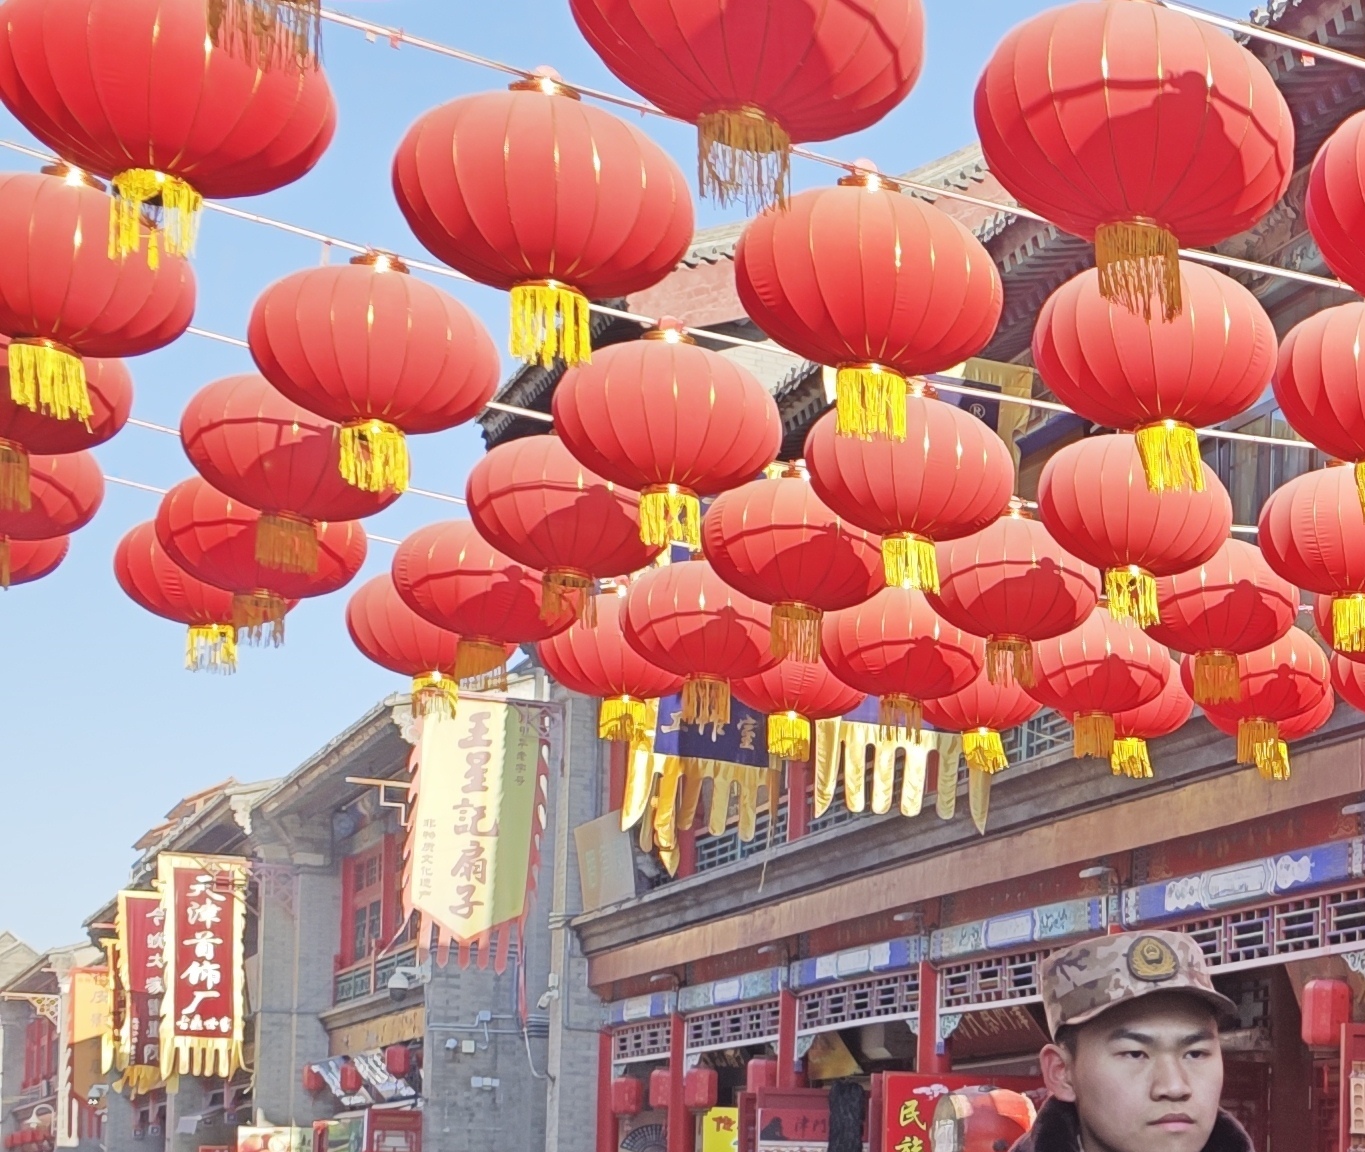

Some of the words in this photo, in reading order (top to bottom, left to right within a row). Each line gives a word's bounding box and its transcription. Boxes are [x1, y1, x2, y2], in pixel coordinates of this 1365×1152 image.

[448, 711, 500, 919] 王星記扇子
[180, 874, 227, 1015] 天津首饰厂
